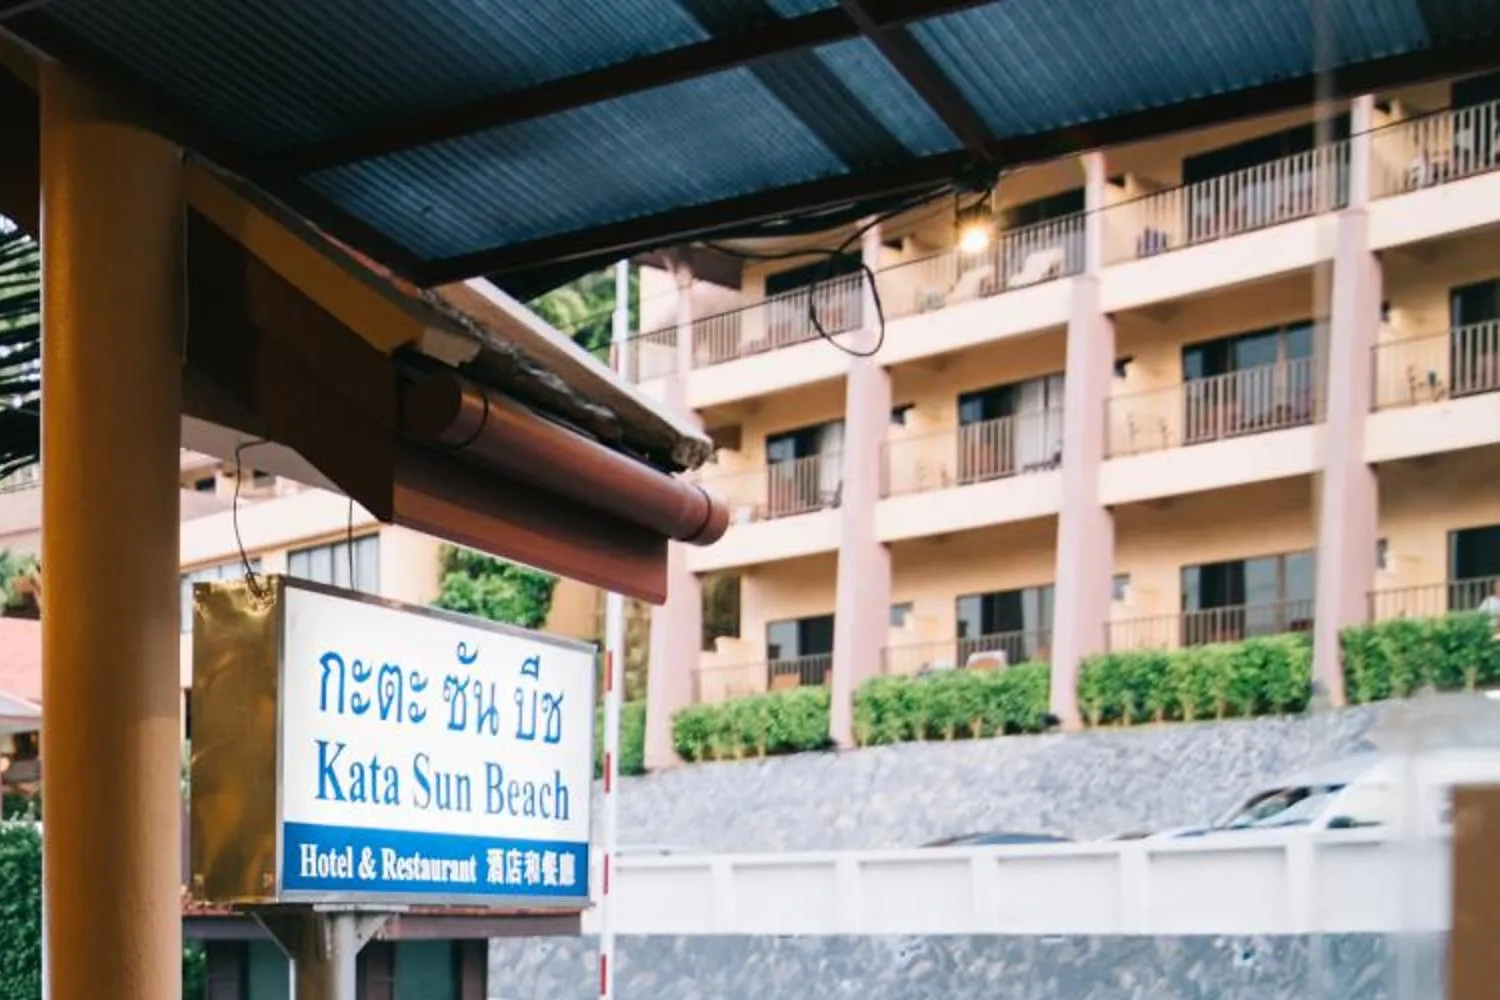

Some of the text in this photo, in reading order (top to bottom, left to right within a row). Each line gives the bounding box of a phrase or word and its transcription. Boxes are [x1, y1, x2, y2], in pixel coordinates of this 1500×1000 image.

[318, 640, 564, 745] กะตะ ซัน บีช
[314, 739, 570, 821] Kata Sun Beach
[299, 843, 354, 880] Hotel
[357, 847, 377, 881] &
[381, 850, 477, 884] Restaurant
